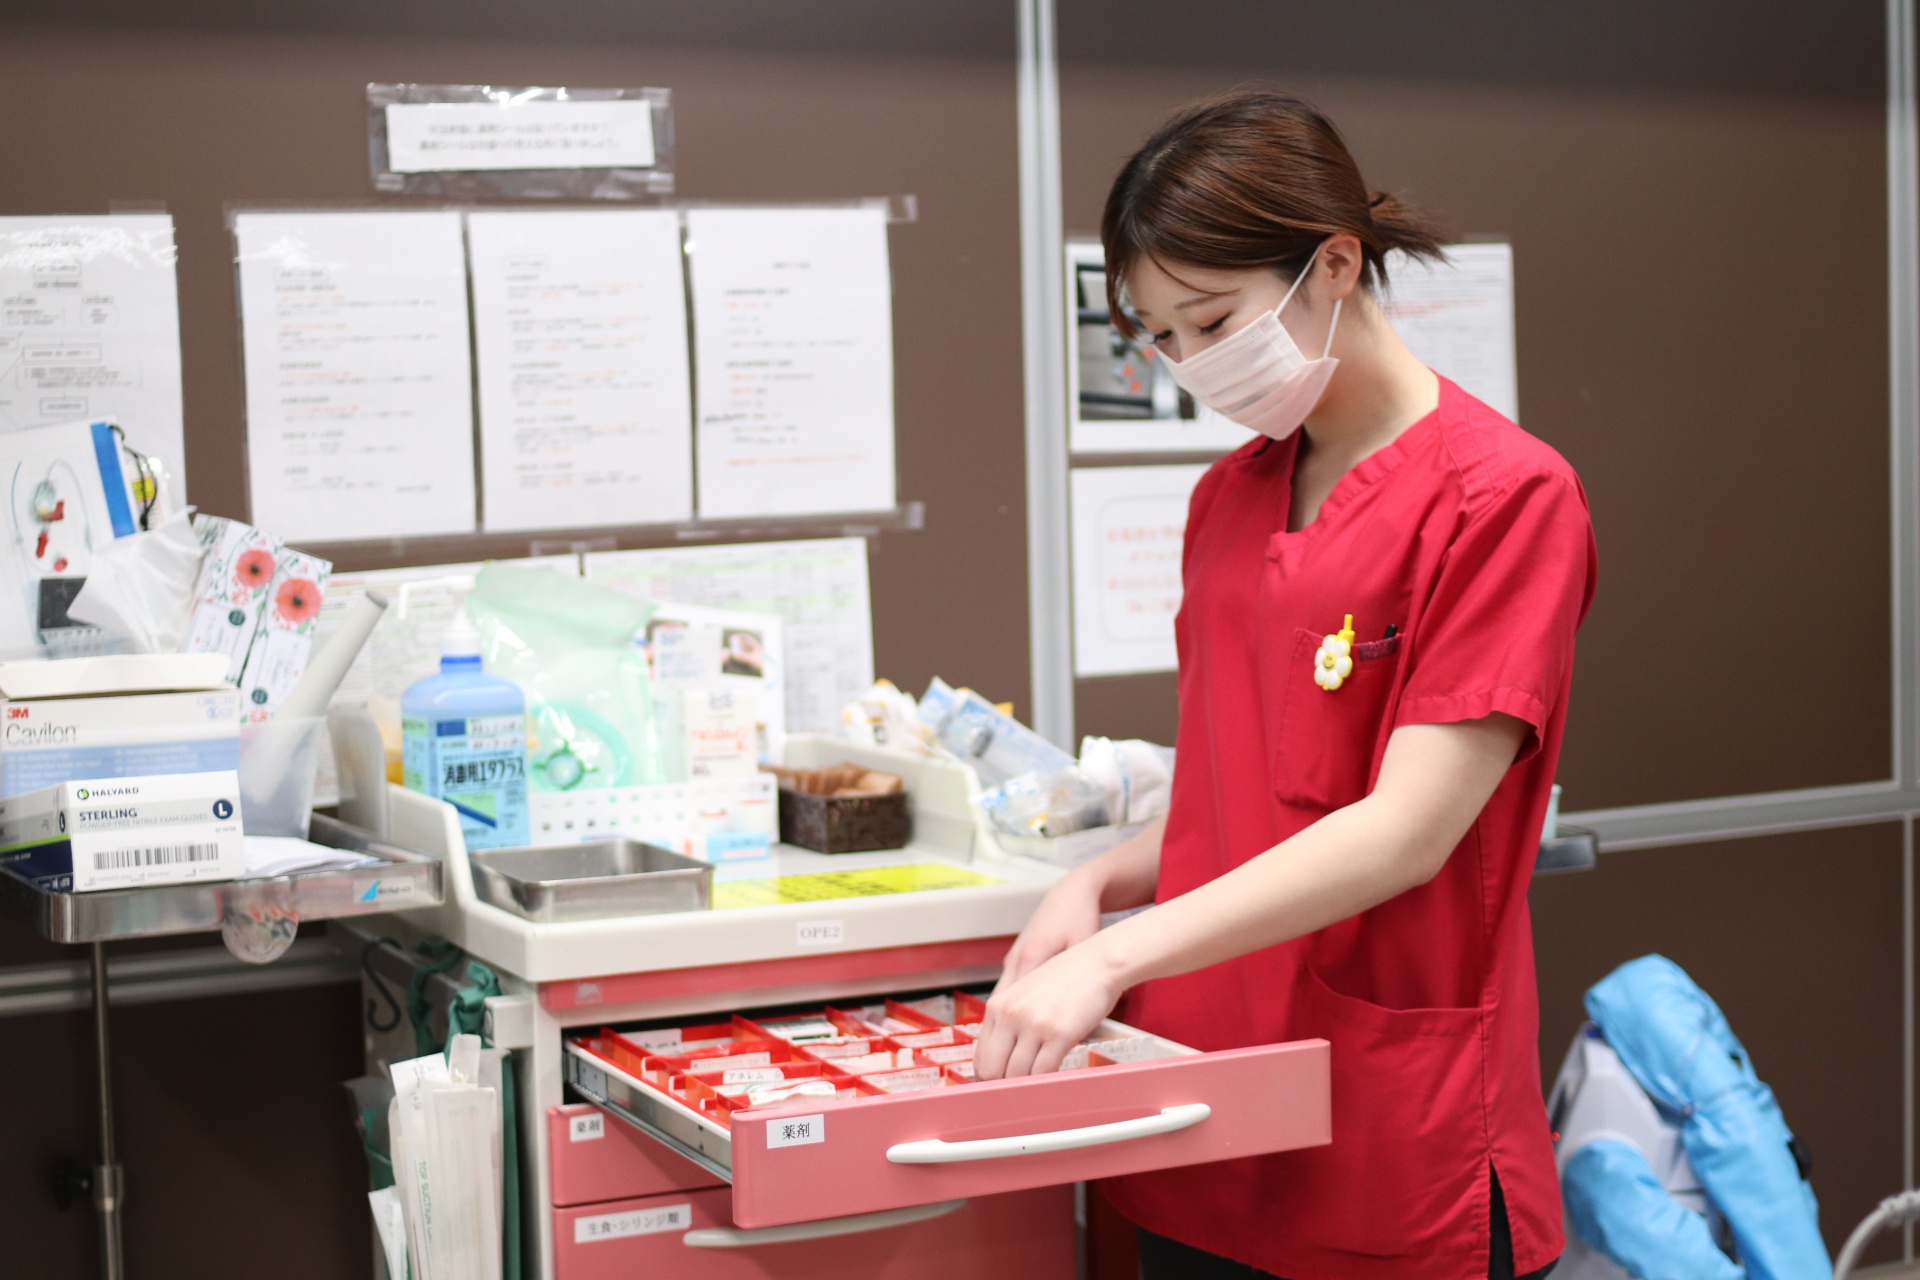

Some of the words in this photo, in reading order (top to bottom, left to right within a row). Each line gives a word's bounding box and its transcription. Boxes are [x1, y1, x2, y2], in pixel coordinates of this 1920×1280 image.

[7, 707, 29, 720] 3M
[6, 722, 76, 747] Cavilon
[92, 787, 139, 797] HALYARD
[79, 807, 138, 822] STERLING
[218, 802, 228, 817] L
[80, 819, 131, 830] POWDER-FREE
[132, 817, 157, 827] NITRILE
[160, 815, 179, 824] EXAM
[180, 812, 208, 822] GLOVES
[800, 925, 840, 940] OPE2
[782, 1122, 810, 1140] 薬剤
[588, 1211, 679, 1236] 生食・シリンジ類
